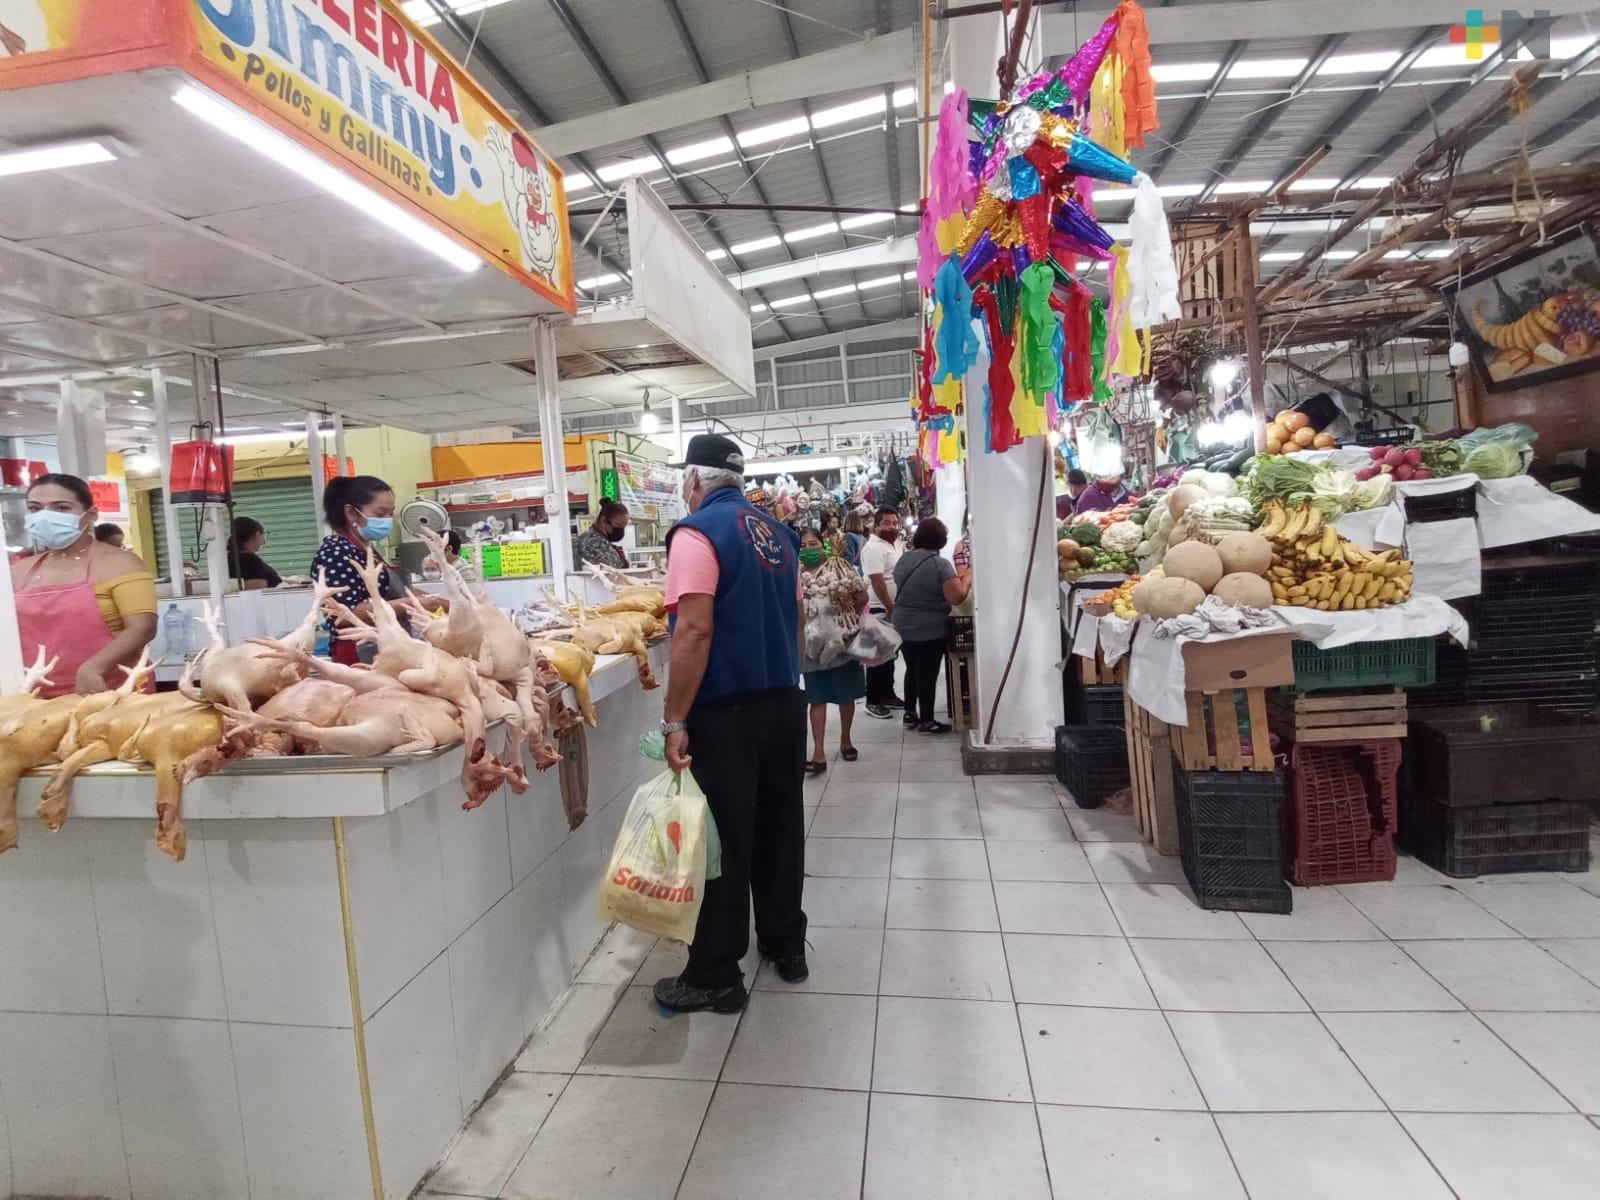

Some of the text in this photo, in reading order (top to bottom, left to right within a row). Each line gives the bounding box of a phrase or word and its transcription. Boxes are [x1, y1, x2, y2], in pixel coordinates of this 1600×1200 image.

[243, 52, 421, 193] Pollos y Gallinas
[311, 0, 459, 124] LERIA
[612, 867, 694, 903] Soriana
